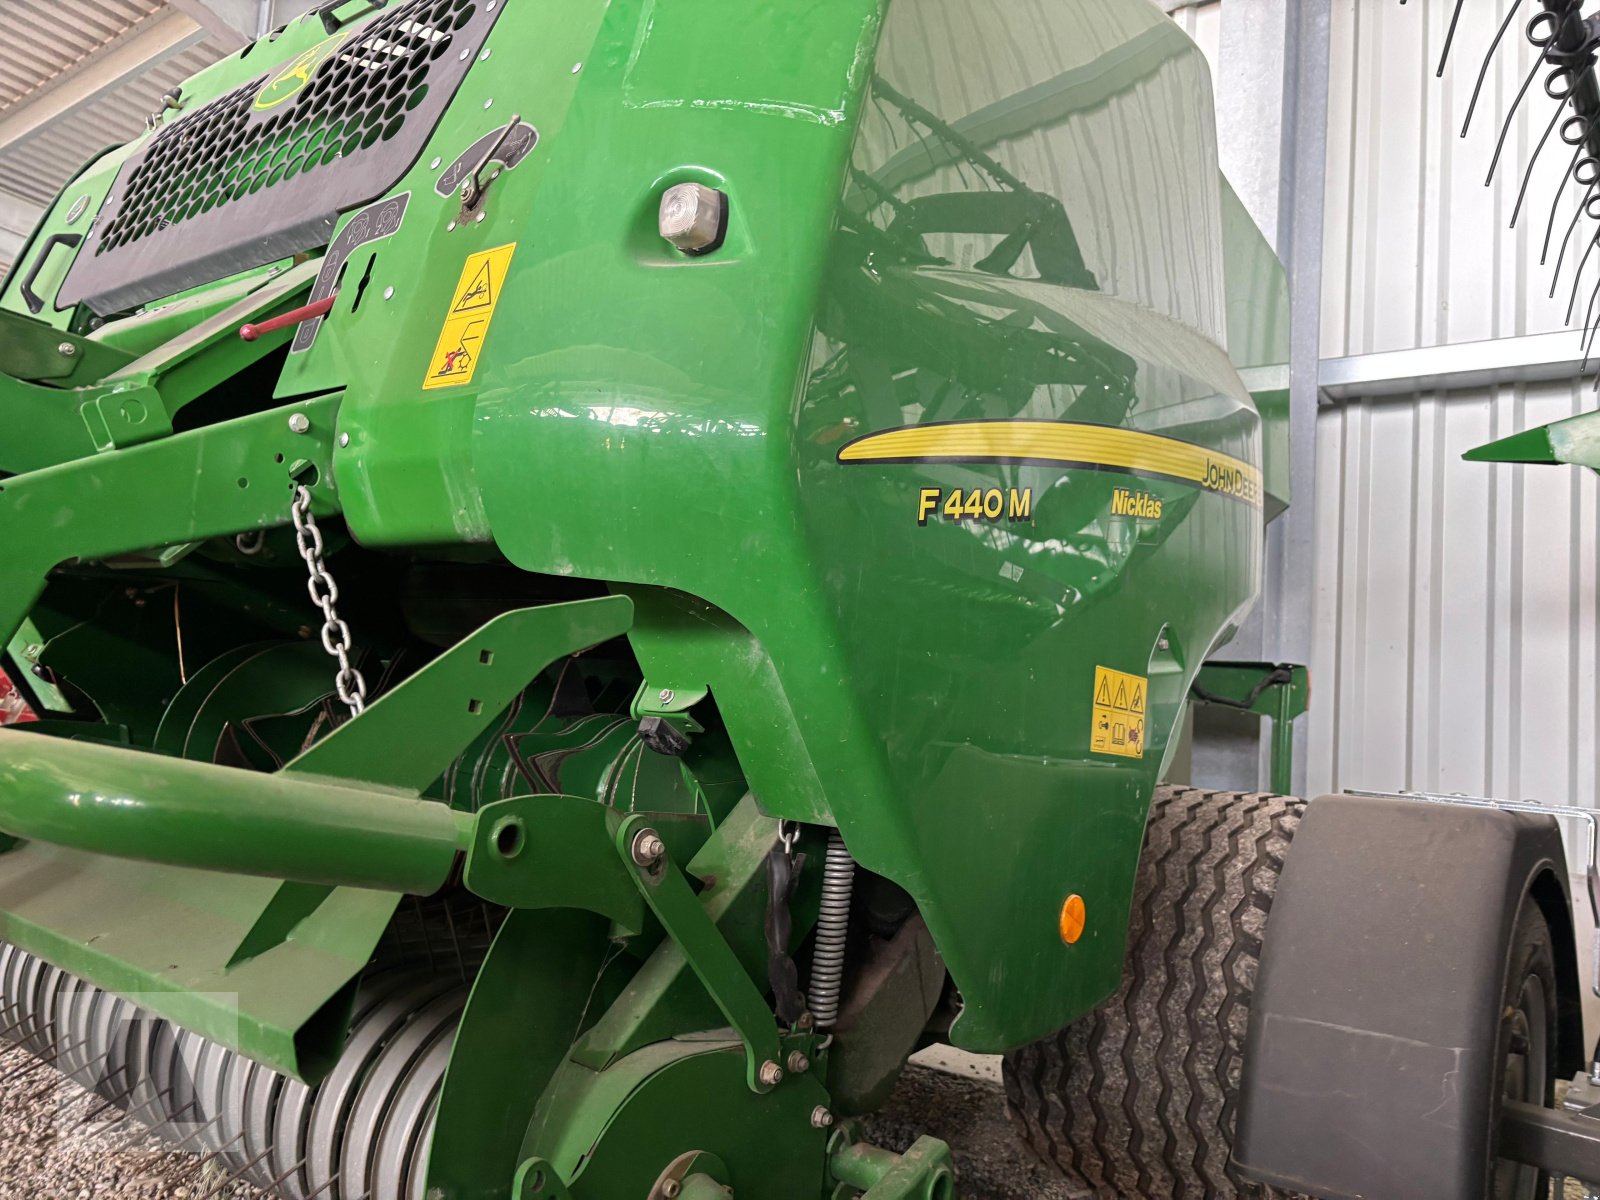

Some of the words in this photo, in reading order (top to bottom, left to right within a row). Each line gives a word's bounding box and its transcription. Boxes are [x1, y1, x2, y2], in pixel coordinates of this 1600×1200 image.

[1202, 458, 1234, 491] JOHN
[918, 488, 942, 526] F
[943, 488, 1004, 524] 440
[1008, 488, 1032, 521] M
[1111, 488, 1162, 519] Nicklas
